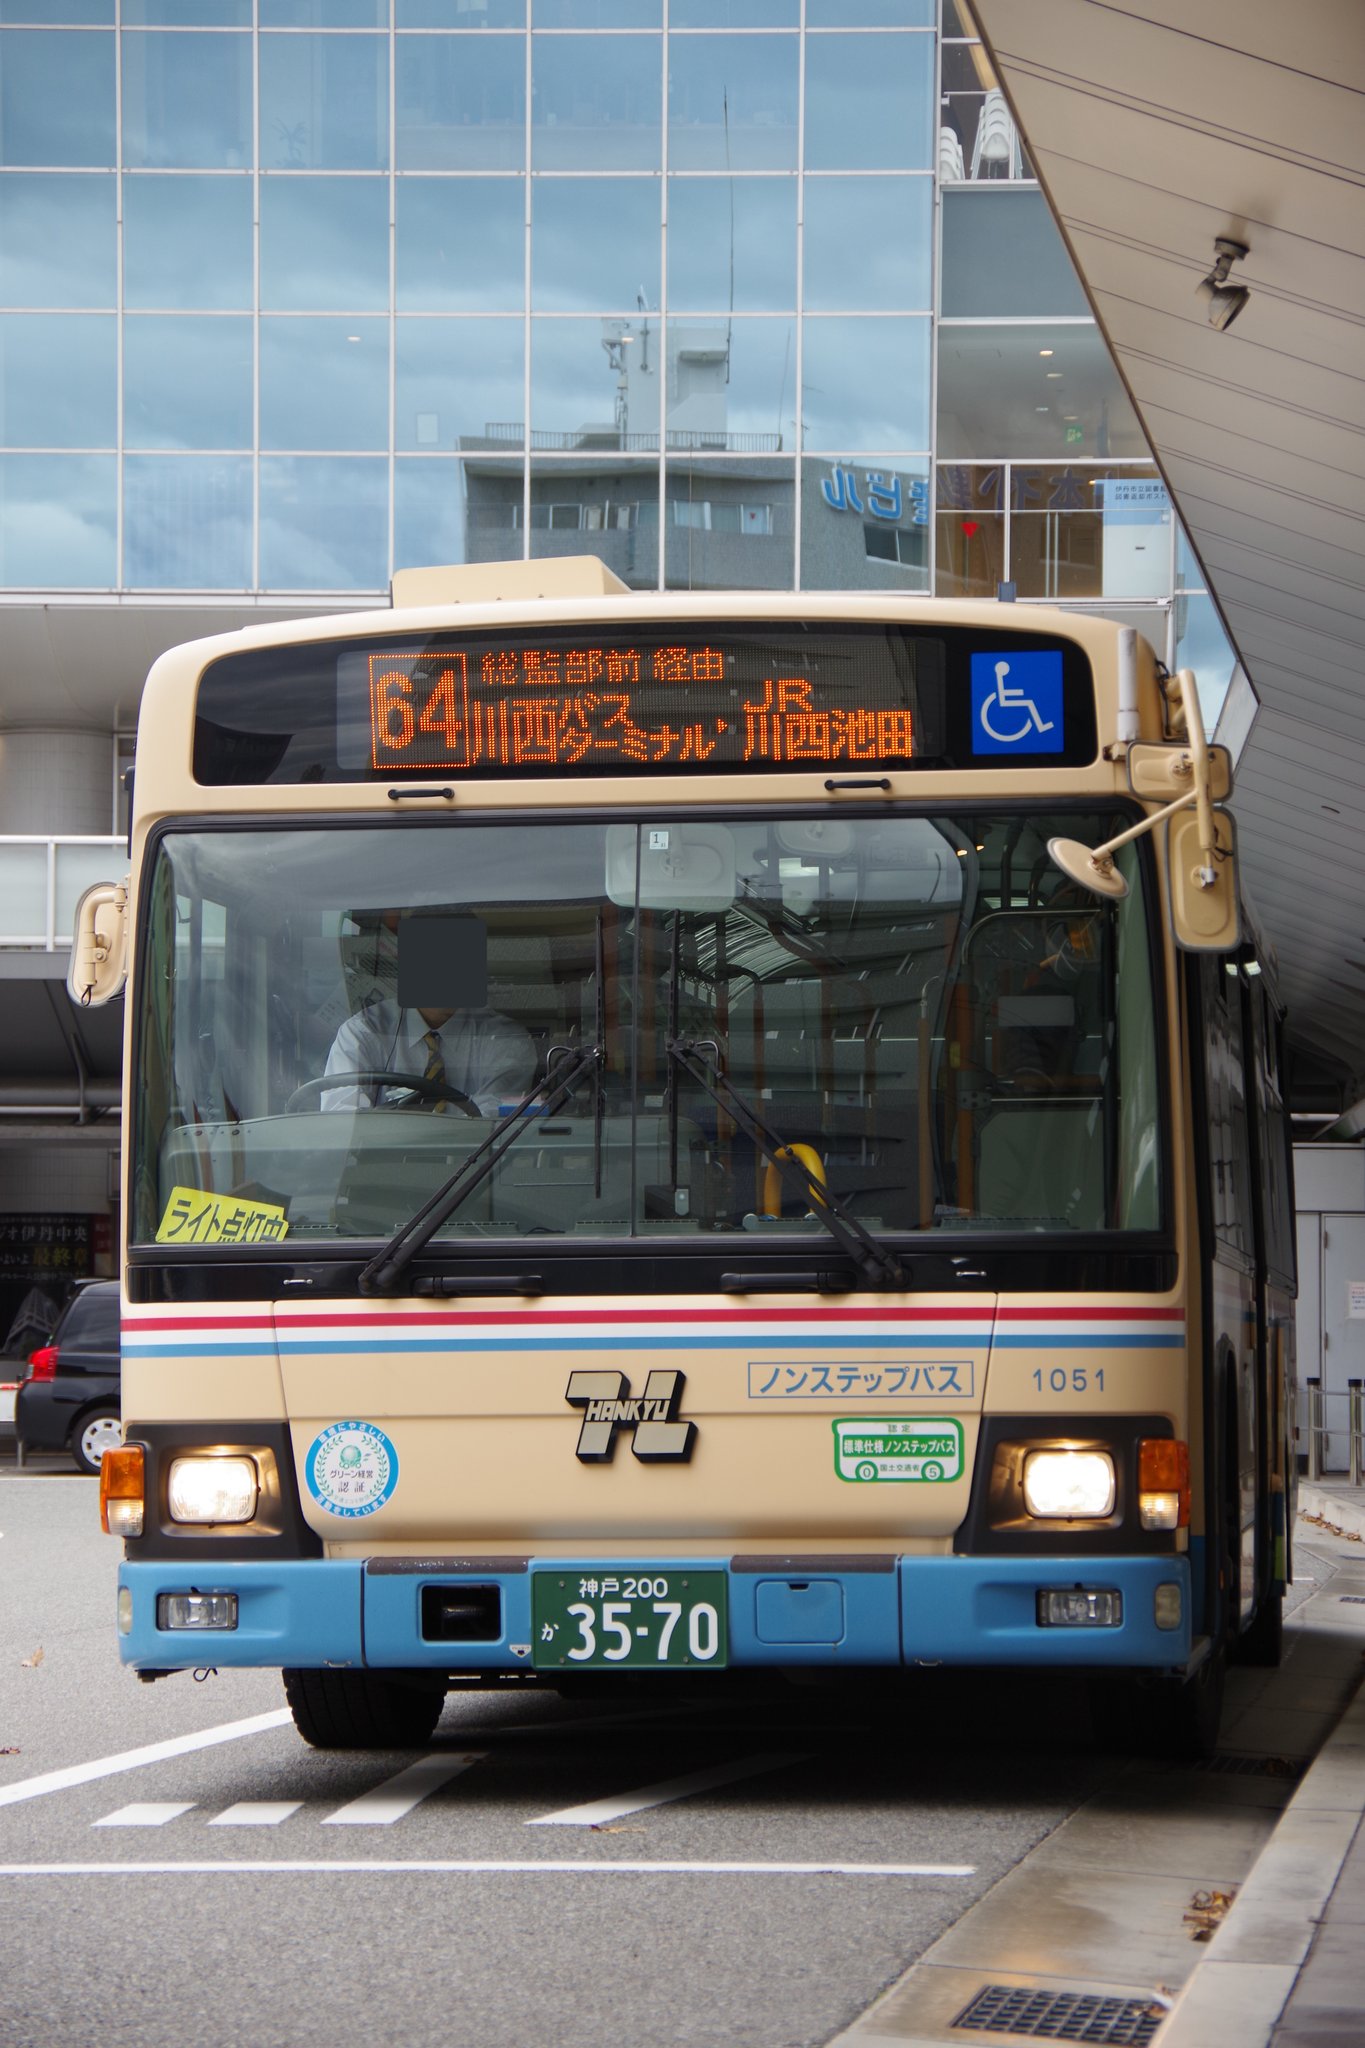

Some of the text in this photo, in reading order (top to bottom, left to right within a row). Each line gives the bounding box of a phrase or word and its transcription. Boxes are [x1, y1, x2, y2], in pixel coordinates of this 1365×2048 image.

[481, 647, 724, 685] 総監部前 経由
[376, 667, 463, 749] 64
[743, 678, 813, 713] JR
[743, 709, 913, 761] 川西池田
[167, 1198, 285, 1242] ライト点灯中
[759, 1365, 963, 1394] ノンステップバス
[1033, 1368, 1106, 1393] 1051
[585, 1400, 671, 1421] HANKYU
[843, 1439, 955, 1454] 標準仕様ノンステップバス
[330, 1469, 374, 1479] グリーン経営
[879, 1463, 920, 1473] 国土交通省
[541, 1602, 718, 1661] か 35-70
